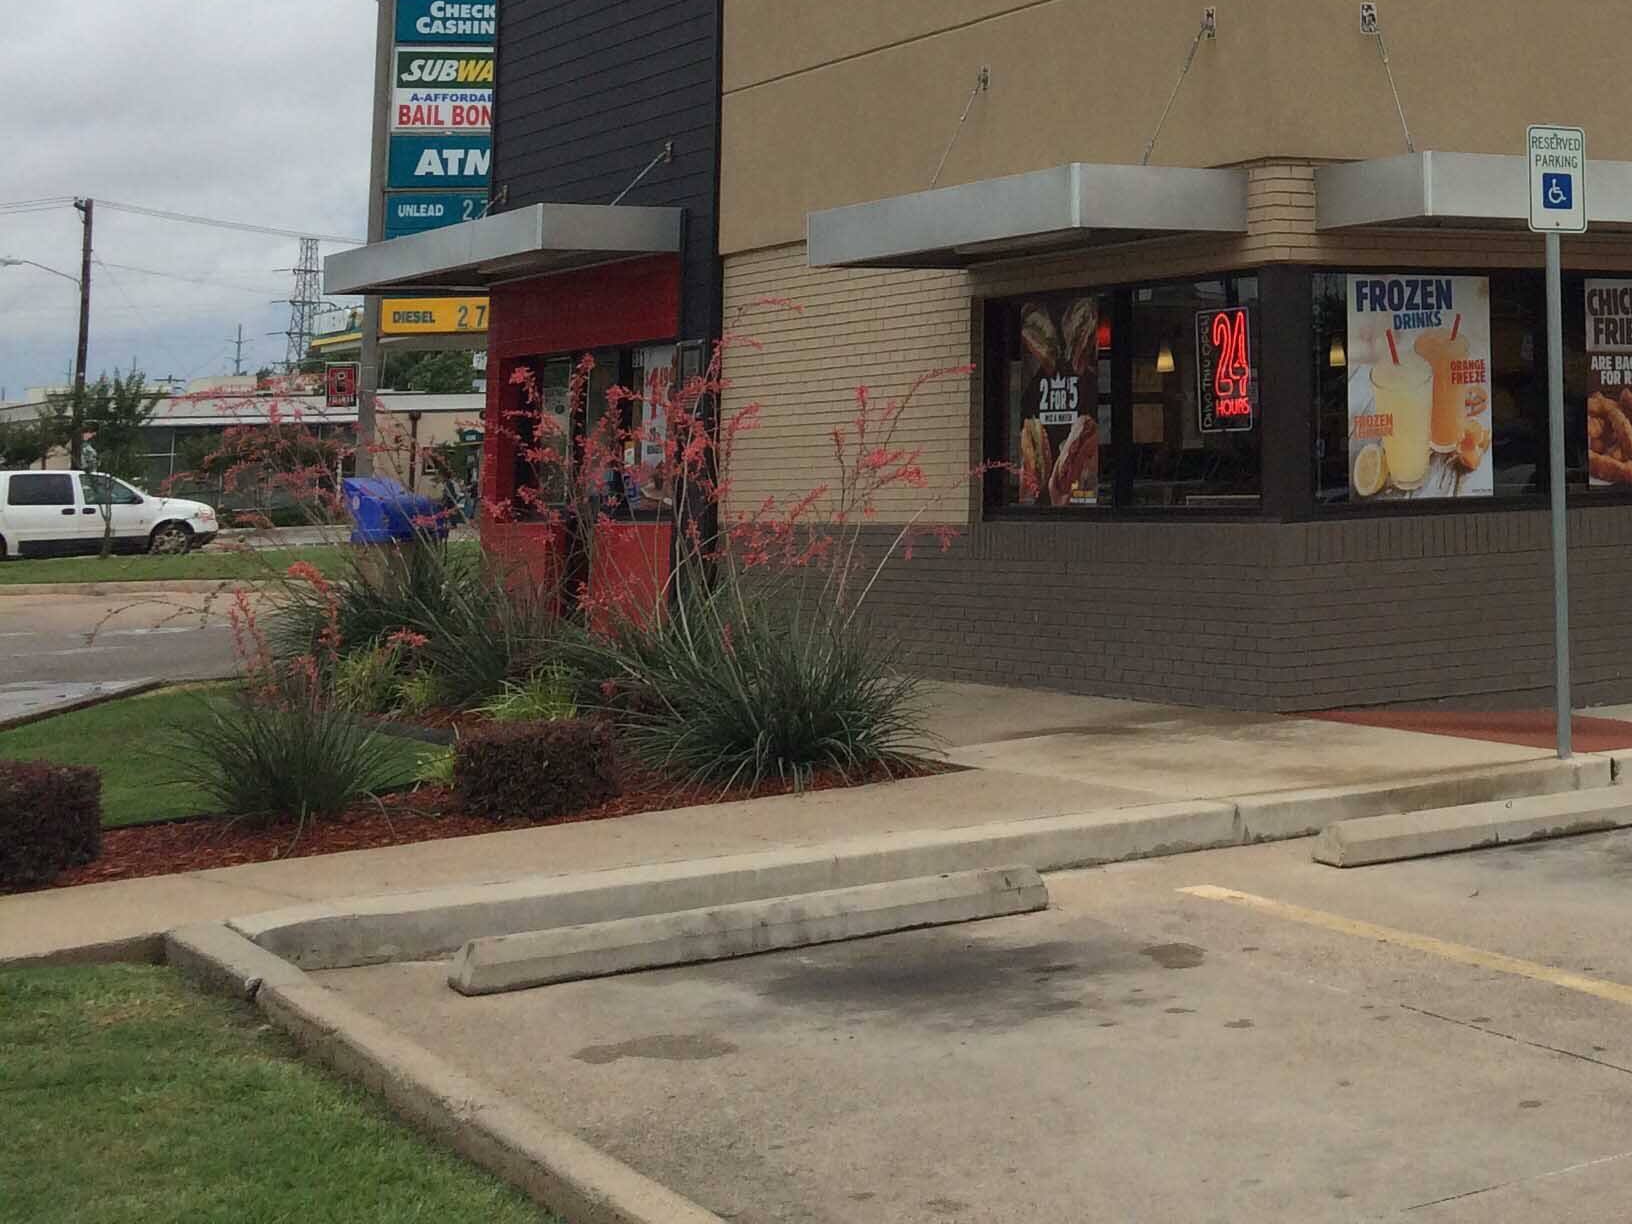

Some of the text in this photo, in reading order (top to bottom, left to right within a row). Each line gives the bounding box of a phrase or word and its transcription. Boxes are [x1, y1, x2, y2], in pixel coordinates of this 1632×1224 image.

[398, 104, 445, 125] BAIL
[1531, 136, 1580, 151] RESERVED
[414, 149, 491, 175] ATM
[1535, 154, 1578, 168] PARKING
[397, 204, 444, 217] UNLEAD
[1355, 279, 1453, 312] FROZEN
[392, 310, 435, 323] DIESEL
[1392, 311, 1443, 330] DRINKS
[1212, 311, 1249, 396] 24
[1450, 359, 1486, 370] ORANGE
[1591, 355, 1612, 370] ARE
[1451, 371, 1487, 385] FREEZE
[1600, 370, 1621, 385] FOR
[1040, 377, 1048, 410] 2
[1050, 390, 1067, 410] FOR
[1215, 397, 1250, 416] HOURS
